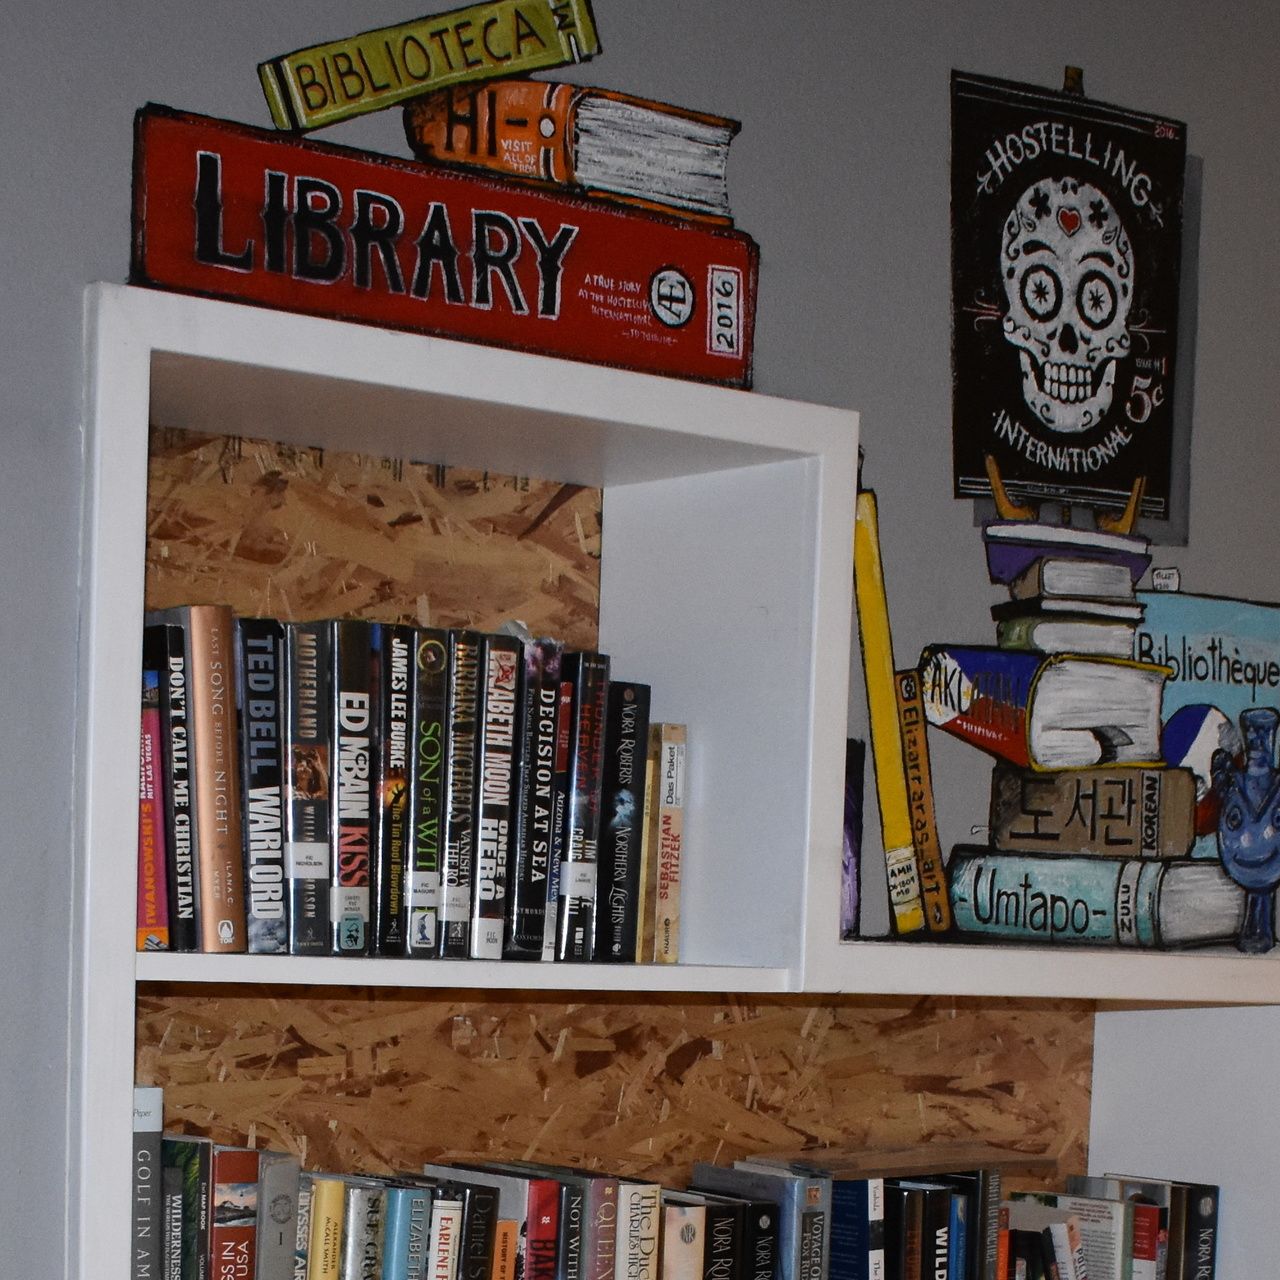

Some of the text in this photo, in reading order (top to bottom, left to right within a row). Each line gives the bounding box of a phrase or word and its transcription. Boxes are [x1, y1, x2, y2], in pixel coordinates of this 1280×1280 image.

[296, 14, 546, 111] BIBLIOTECA
[502, 139, 532, 151] VISIT
[504, 153, 522, 162] ALL
[986, 122, 1152, 207] HOSTELLING
[194, 150, 578, 320] LIBRARY
[717, 280, 734, 349] 2016
[993, 409, 1133, 473] INTERNATIONAL
[297, 633, 317, 739] MOTHERLAND
[1138, 633, 1280, 702] Bibliothèque
[210, 628, 228, 835] LAST SONG BEFORE NIGHT
[246, 635, 278, 775] TED BELL
[389, 638, 408, 769] JAMES LEE BURKE
[169, 656, 194, 919] DON'T CALL ME CHRISTIAN
[531, 688, 556, 883] DECISION AT SEA
[666, 746, 676, 805] Das Paket
[1009, 779, 1136, 846] 도서관
[1143, 776, 1158, 850] KOREAN
[248, 785, 285, 920] WARLORD
[339, 824, 370, 887] KISS
[478, 818, 499, 900] HERO
[495, 820, 509, 900] ONCE A
[571, 828, 584, 861] CRAIG
[585, 839, 597, 859] TIM
[659, 815, 672, 900] SEBASTIAN
[670, 833, 680, 883] FITZEK
[1121, 884, 1132, 933] ZULU
[137, 1150, 151, 1209] GOLF
[640, 1190, 660, 1232] The
[137, 1216, 151, 1239] IN
[435, 1216, 453, 1270] EARLENE
[571, 1196, 582, 1232] NOT
[628, 1192, 642, 1246] CHARLES
[712, 1217, 735, 1253] NORA
[802, 1232, 811, 1256] FOX
[811, 1216, 824, 1263] VOYAGE
[222, 1240, 236, 1261] IN
